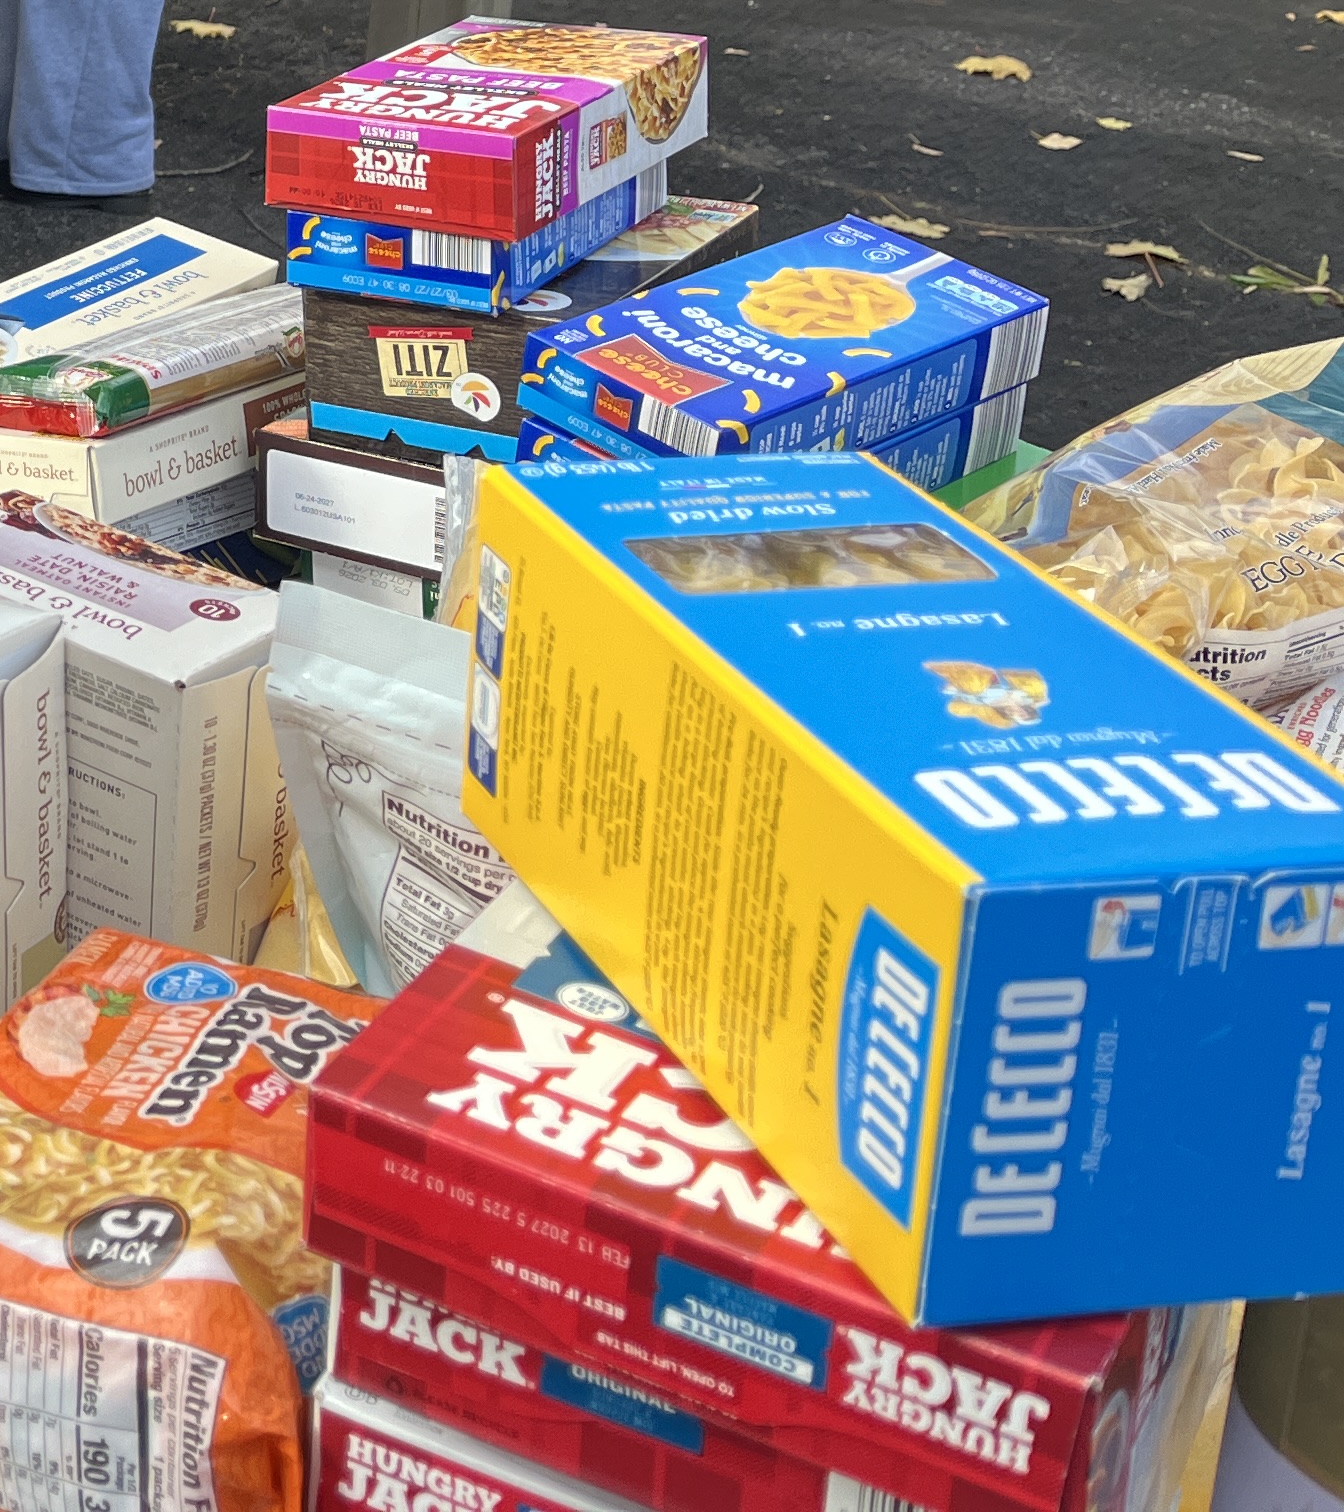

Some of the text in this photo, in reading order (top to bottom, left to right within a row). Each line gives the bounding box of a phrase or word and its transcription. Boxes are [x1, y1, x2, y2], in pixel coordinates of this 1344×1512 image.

[304, 80, 522, 130] HUNGRY
[397, 83, 562, 118] JACK
[352, 145, 431, 175] JACK
[352, 168, 429, 191] HUNGRY
[68, 266, 149, 306] FETTUCCINE
[391, 342, 451, 378] ZITI
[620, 305, 796, 392] macaroni
[5, 459, 19, 478] &
[21, 461, 75, 483] basket
[122, 435, 240, 499] bowl & basket
[294, 491, 336, 507] 06-24-2027
[669, 500, 837, 526] Slow dried
[1238, 554, 1307, 594] EGG
[915, 750, 1342, 830] DE CECCO
[386, 796, 491, 860] Nutrition
[809, 894, 839, 1045] Lasagne
[101, 1003, 211, 1100] CHICKEN
[141, 983, 306, 1127] Ramen
[857, 945, 930, 1192] DE CECCO
[959, 975, 1089, 1238] DE CECCO
[86, 1238, 161, 1268] PACK
[97, 1205, 177, 1237] 5
[489, 1255, 626, 1321] BEST IF USED BY:
[358, 1287, 533, 1389] JACK
[182, 1350, 222, 1481] Nutrition
[842, 1334, 1052, 1440] JACK
[840, 1377, 1034, 1475] HUNGRY
[345, 1431, 502, 1511] HUNGRY
